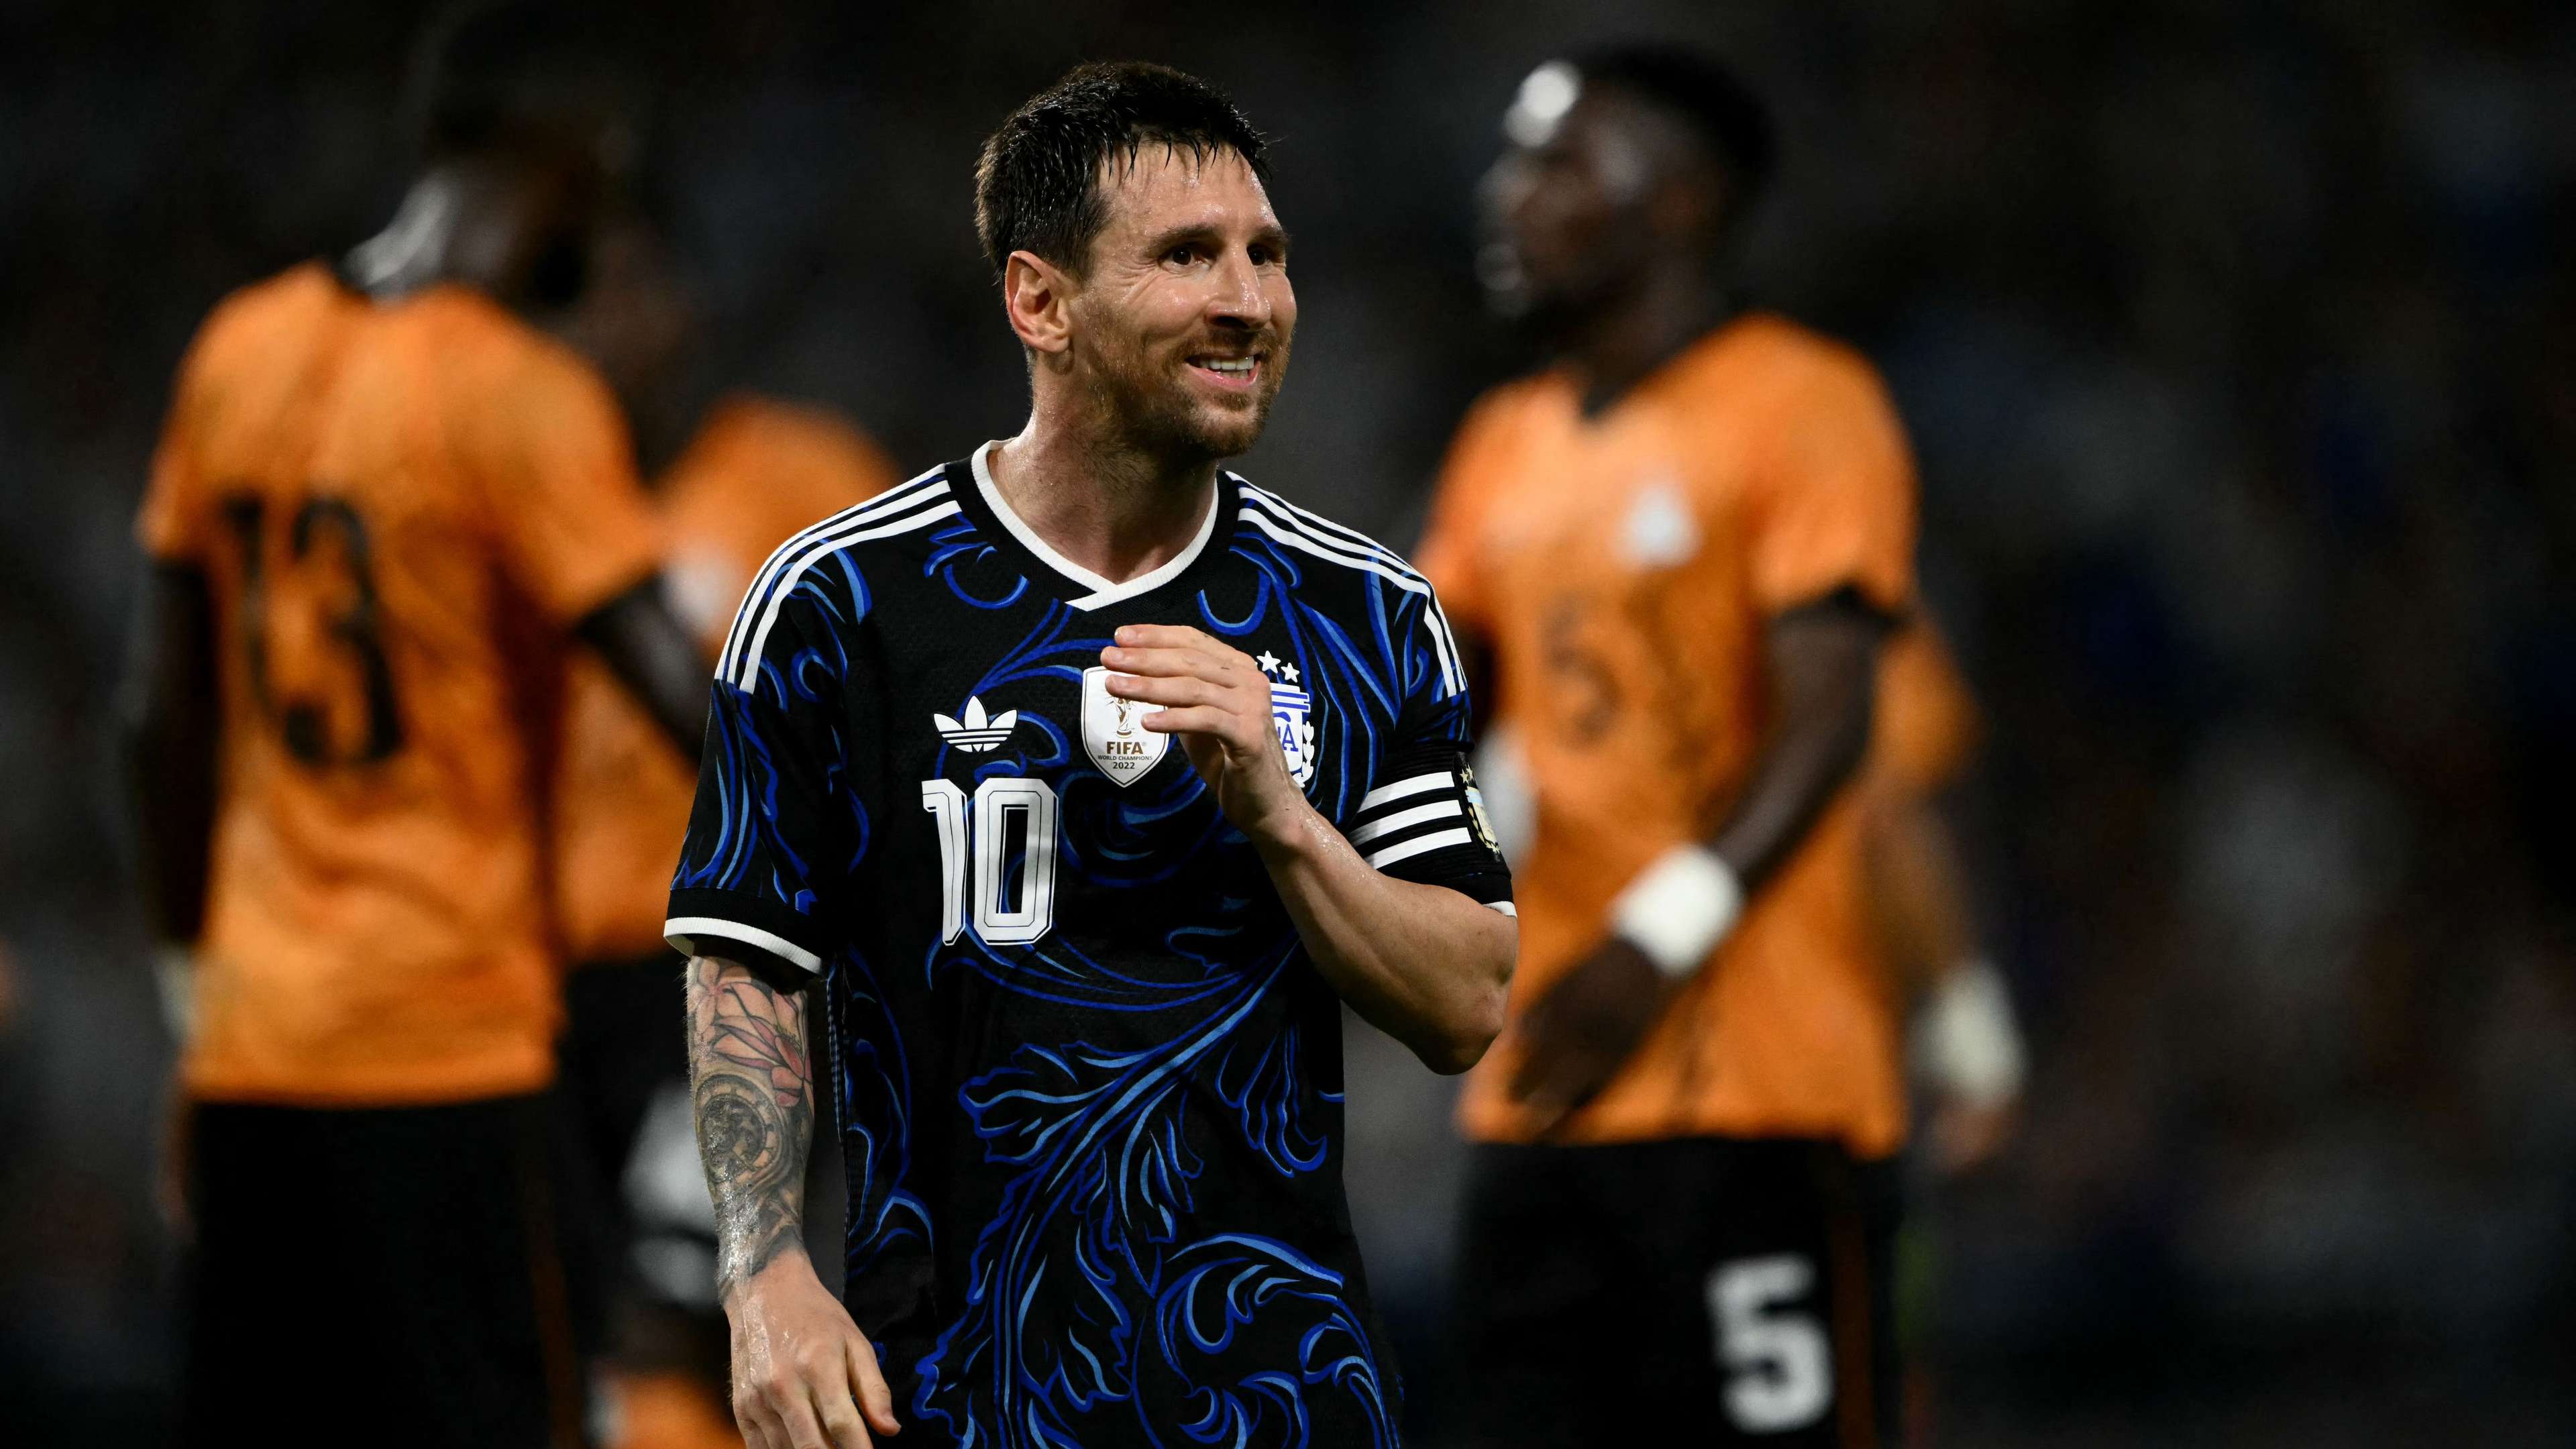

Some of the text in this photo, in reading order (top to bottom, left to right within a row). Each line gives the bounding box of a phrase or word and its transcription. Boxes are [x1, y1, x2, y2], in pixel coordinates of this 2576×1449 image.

[220, 493, 404, 770] 13
[1106, 741, 1144, 755] FIFA
[1112, 761, 1135, 769] 2022
[922, 777, 1059, 946] 10
[1707, 1252, 1835, 1434] 5
